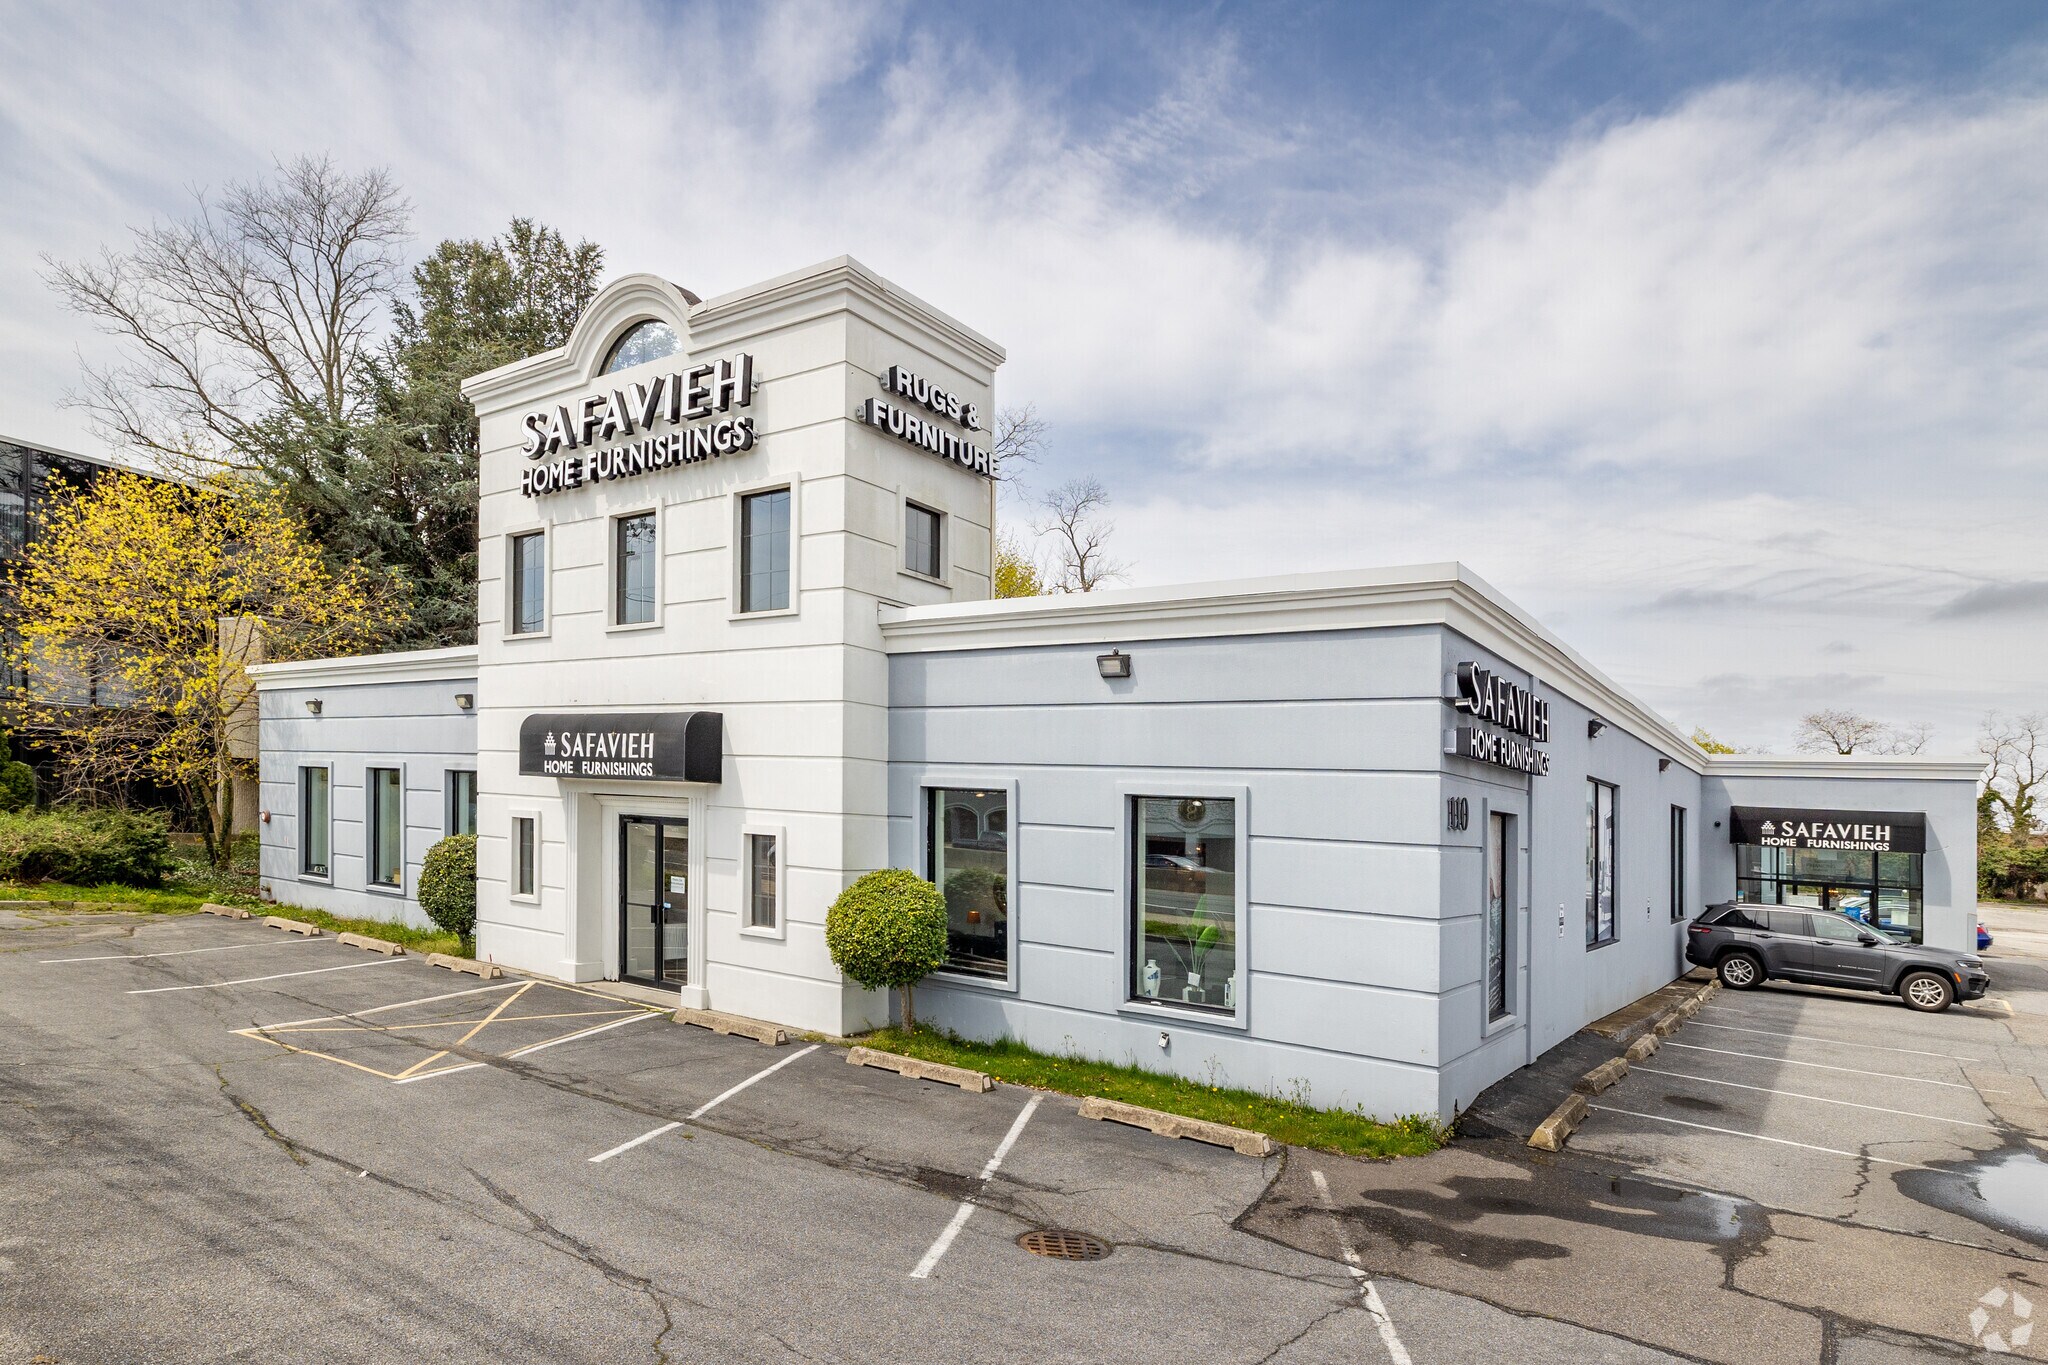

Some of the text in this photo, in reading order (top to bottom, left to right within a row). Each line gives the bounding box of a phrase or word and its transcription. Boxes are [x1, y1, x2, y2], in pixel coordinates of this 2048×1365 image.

[520, 353, 753, 460] SAFAVIEH
[889, 365, 981, 432] RUGS &
[520, 416, 753, 498] HOME FURNISHINGS
[866, 397, 1001, 480] FURNITURE
[1459, 661, 1550, 743] SAFAVIEH
[544, 760, 653, 776] HOME FURNISHINGS
[561, 731, 654, 759] SAFAVIEH
[1470, 727, 1498, 763] HOME
[1761, 837, 1889, 851] HOME FURNISHINGS
[1781, 821, 1890, 841] SAFAVIEH
